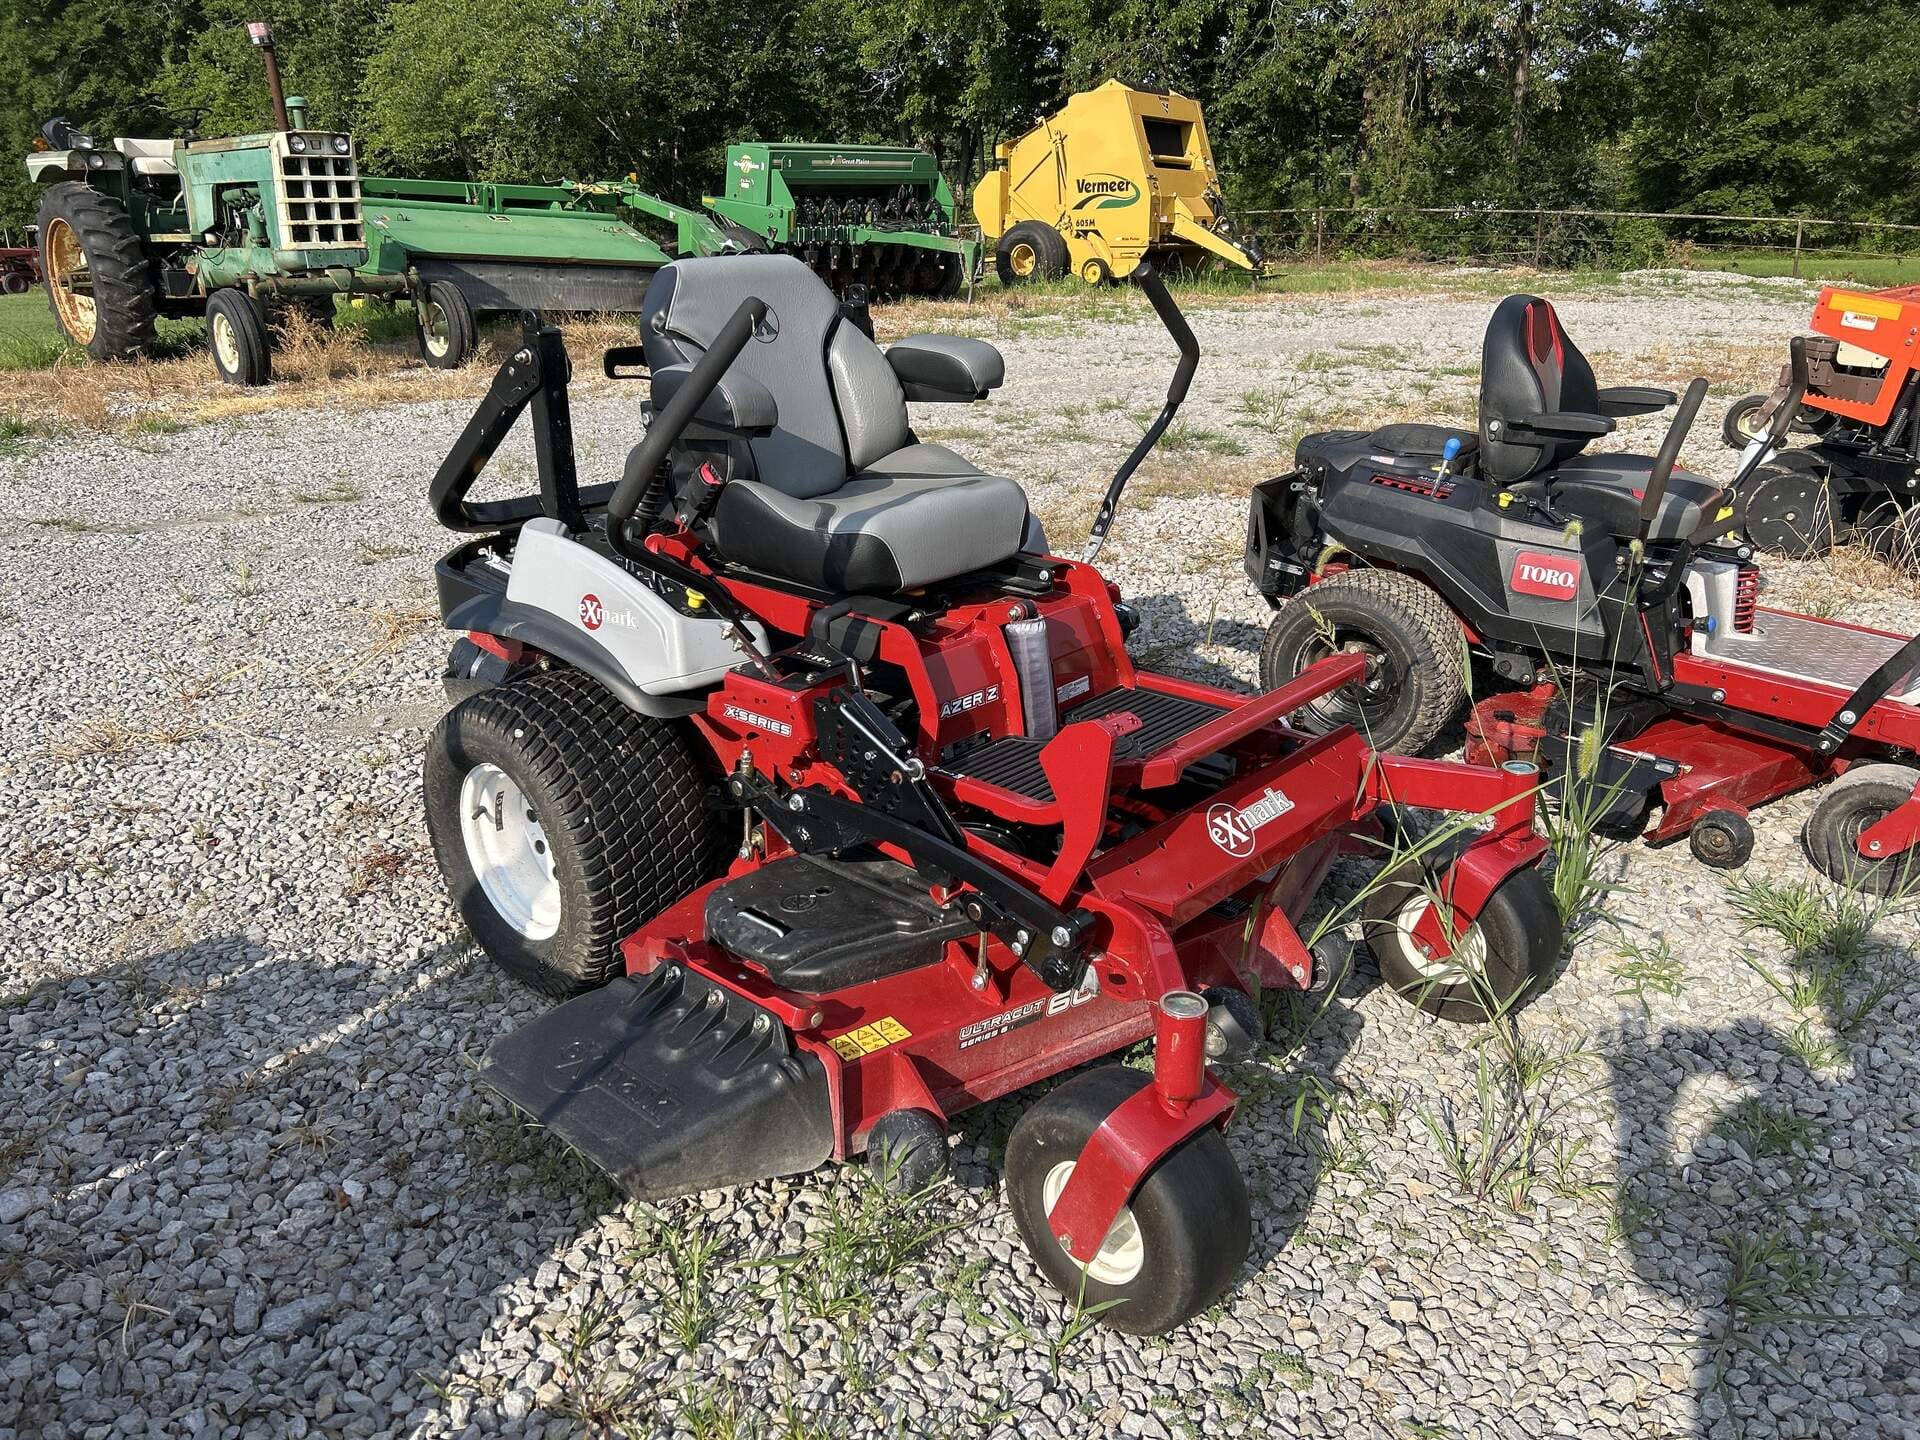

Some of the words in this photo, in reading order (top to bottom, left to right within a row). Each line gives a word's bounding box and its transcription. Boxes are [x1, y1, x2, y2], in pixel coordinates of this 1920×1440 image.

[1076, 179, 1131, 193] Vermeer
[1075, 218, 1096, 227] 605M
[941, 692, 984, 718] AZER
[987, 685, 998, 702] Z
[725, 706, 791, 736] X-SERIES
[960, 999, 1044, 1038] ULTRACUT
[960, 1029, 998, 1048] SERIES
